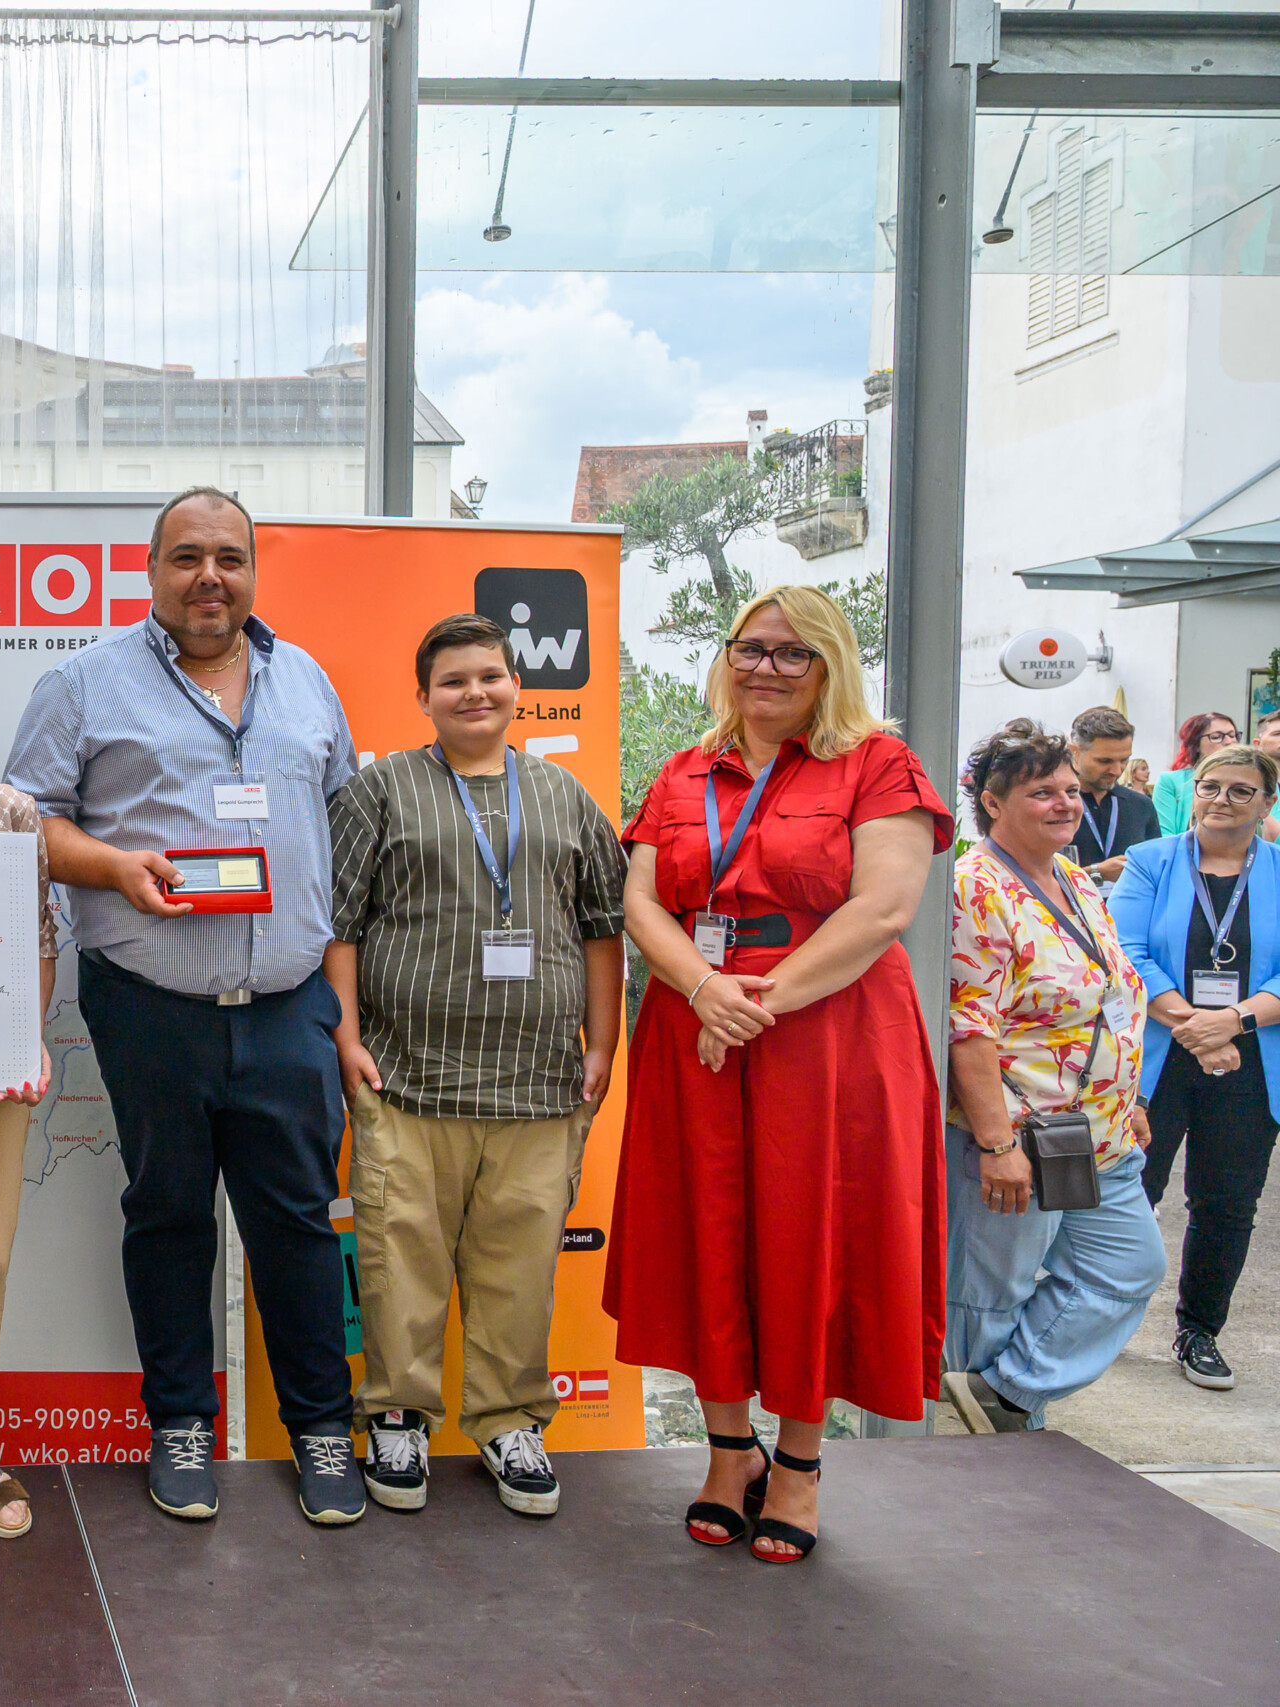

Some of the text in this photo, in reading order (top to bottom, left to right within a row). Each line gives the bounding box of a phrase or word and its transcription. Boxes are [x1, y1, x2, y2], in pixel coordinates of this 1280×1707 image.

[1020, 660, 1076, 670] TRUMER
[1034, 671, 1062, 680] PILS
[54, 1036, 78, 1045] Sankt
[52, 1134, 98, 1144] Hofkirchen
[575, 1410, 610, 1419] Linz-Land
